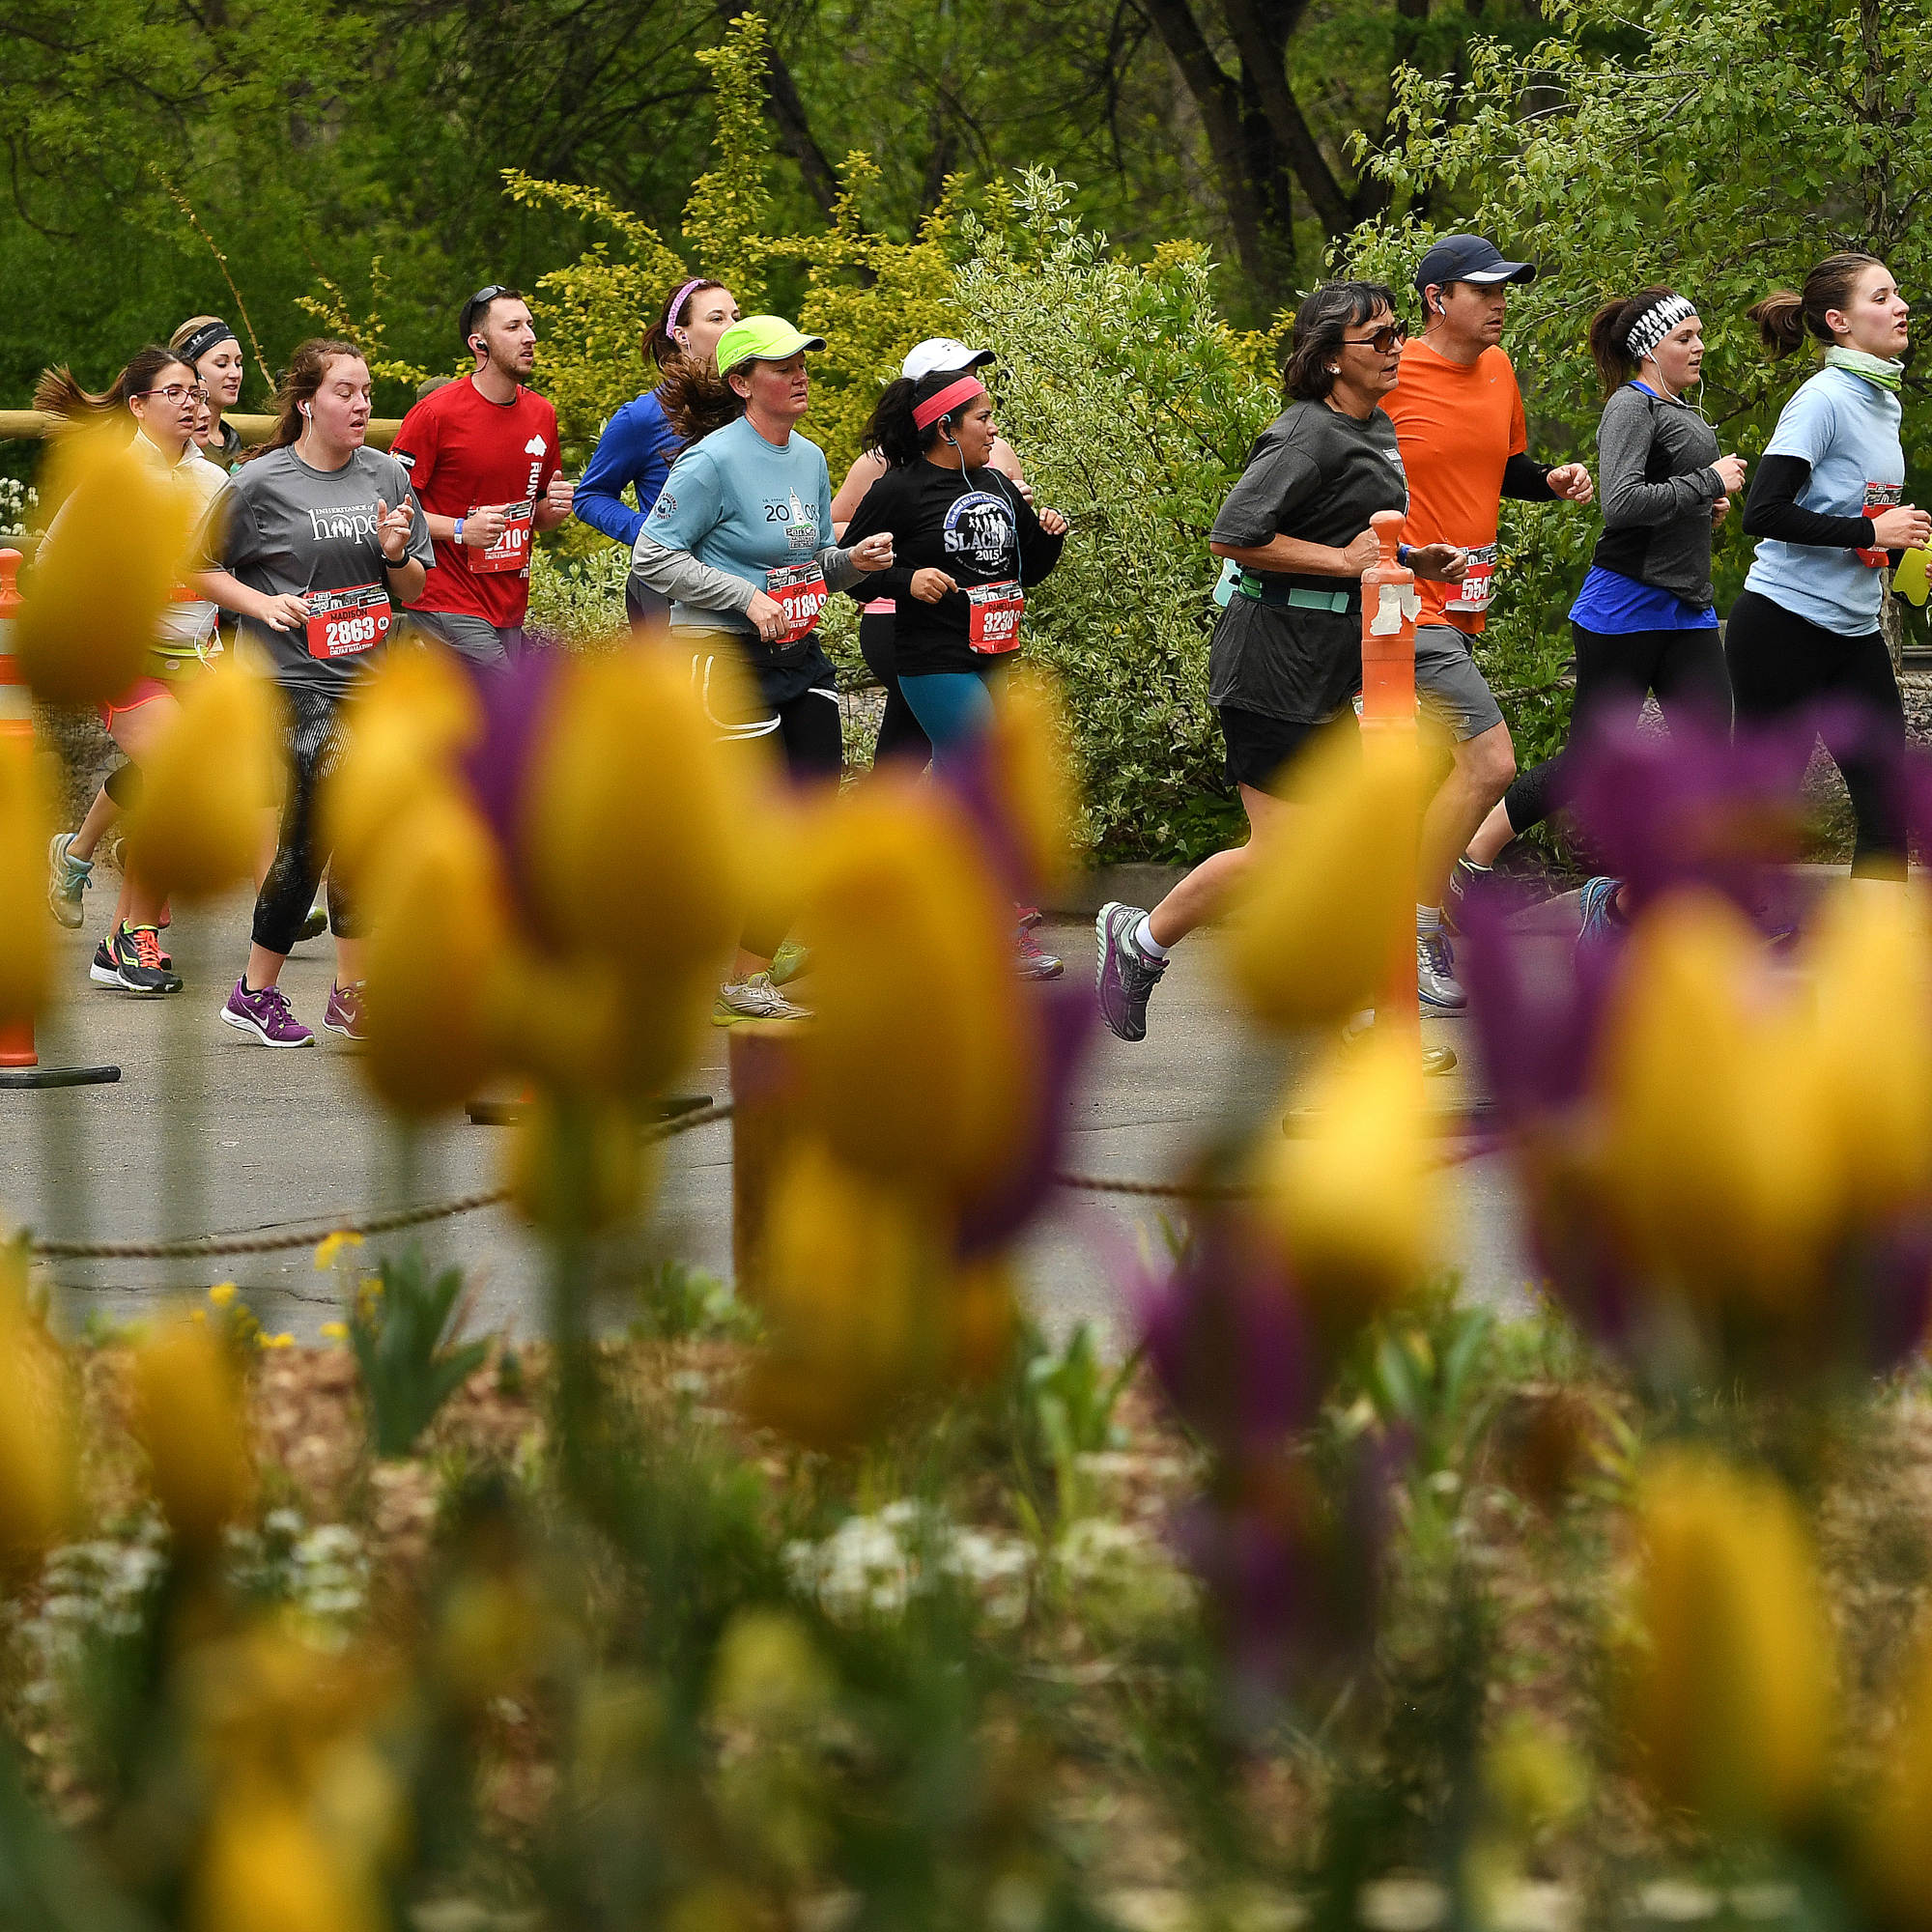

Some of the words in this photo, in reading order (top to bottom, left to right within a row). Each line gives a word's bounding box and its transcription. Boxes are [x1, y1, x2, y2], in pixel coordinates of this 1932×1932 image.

[484, 528, 522, 553] 210
[975, 549, 1000, 560] 2015
[1462, 576, 1491, 601] 554
[330, 608, 367, 621] MADISON
[782, 593, 818, 621] 3189
[326, 616, 375, 646] 2863
[983, 610, 1014, 634] 3238
